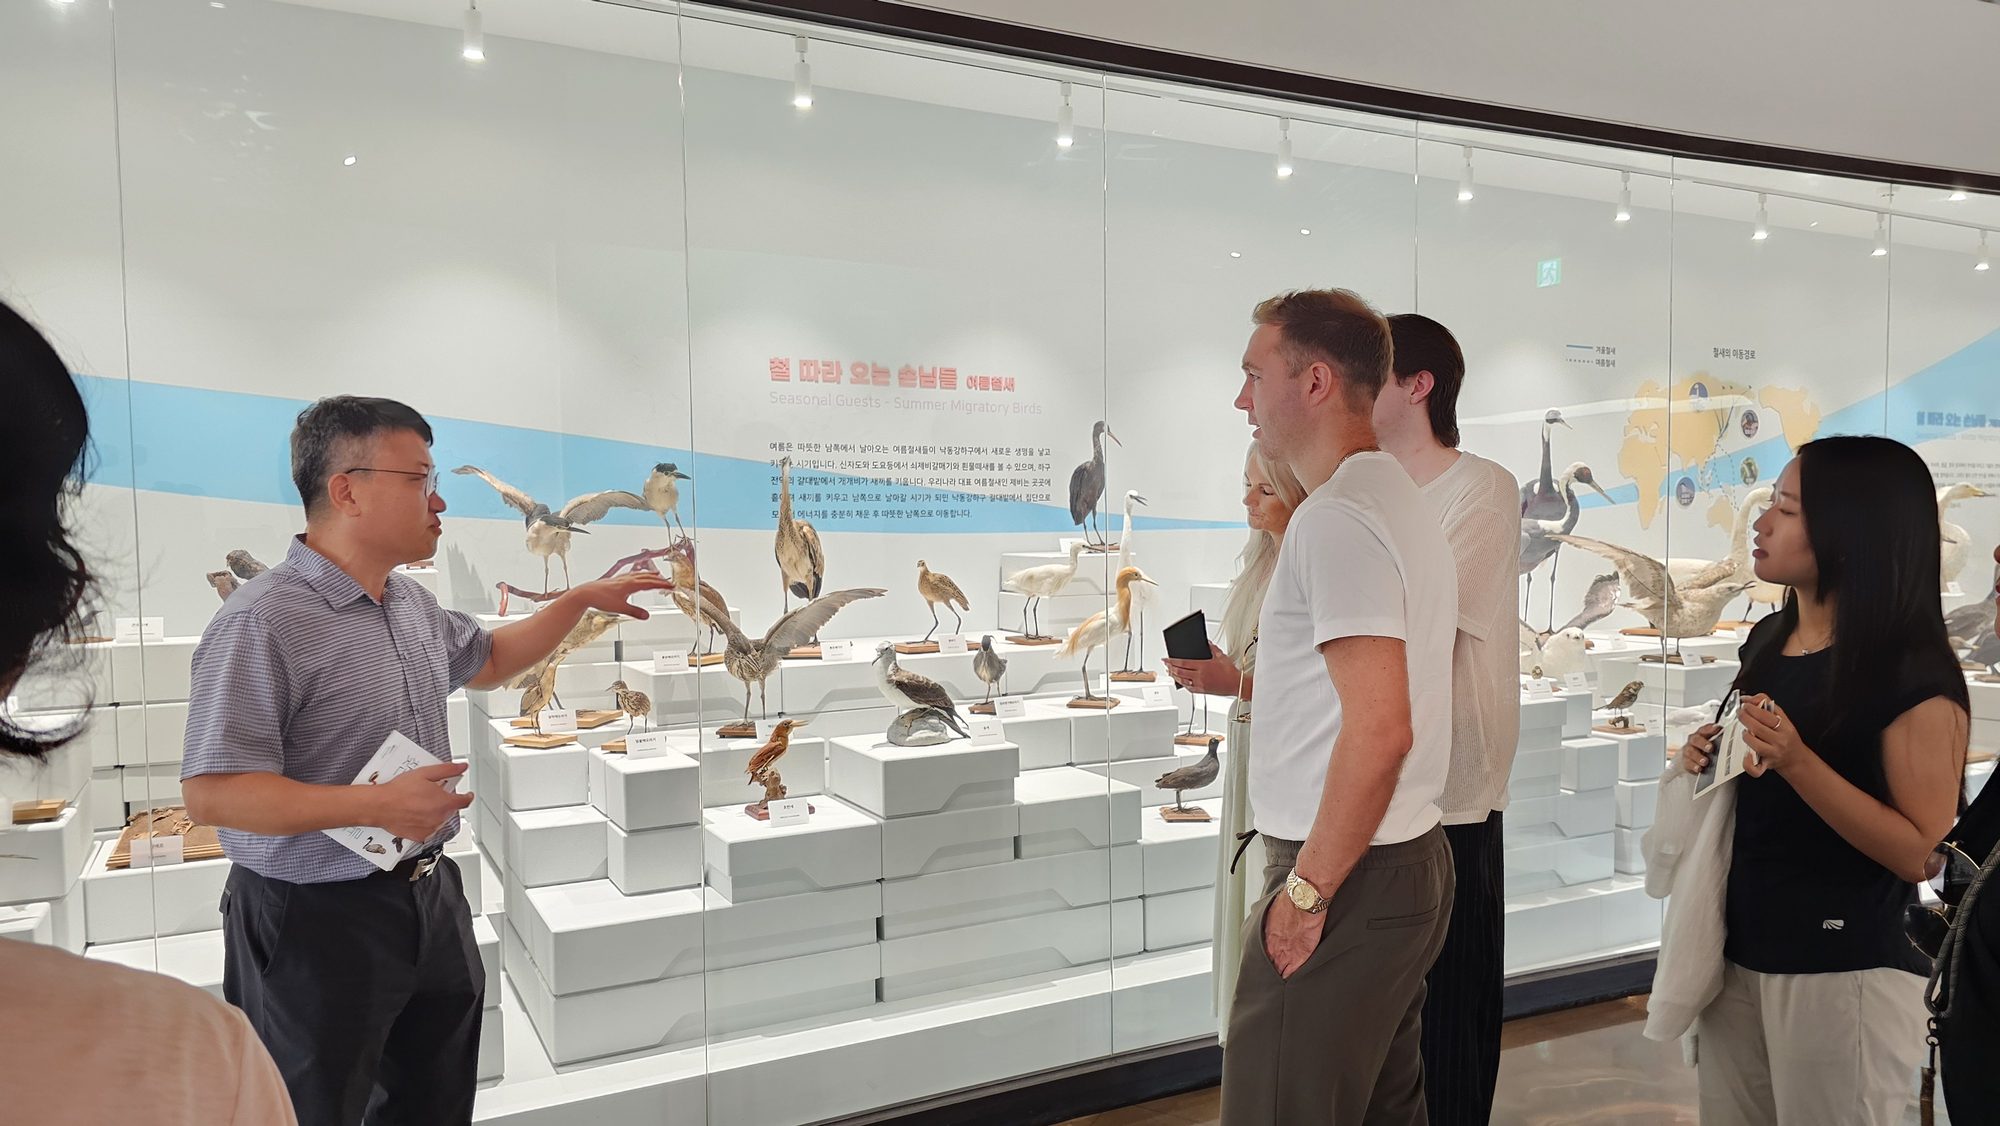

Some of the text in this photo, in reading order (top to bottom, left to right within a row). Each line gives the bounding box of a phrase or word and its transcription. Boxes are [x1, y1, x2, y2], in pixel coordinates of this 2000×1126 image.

[1713, 347, 1756, 360] 철새의 이동경로
[769, 357, 1016, 392] 철 따라 오는 손님들 여름철새
[769, 391, 832, 406] Seasonal
[836, 394, 880, 408] Guests
[894, 396, 948, 411] Summer
[950, 400, 1008, 416] Migratory
[1012, 402, 1042, 414] Birds
[770, 442, 793, 452] 여름은
[798, 443, 821, 452] 따뜻한
[825, 444, 855, 453] 남쪽에서
[860, 444, 889, 454] 날아오는
[892, 445, 936, 454] 여름철새들이
[940, 446, 988, 455] 낙동강하구에서
[796, 460, 838, 469] 시기입니다.
[1015, 463, 1036, 471] 있으며,
[928, 478, 956, 486] 우리나라
[958, 478, 972, 487] 대표
[826, 493, 848, 502] 키우고
[852, 493, 881, 502] 남쪽으로
[885, 494, 907, 502] 날아갈
[911, 494, 932, 502] 시기가
[797, 510, 828, 519] 에너지를
[873, 510, 879, 518] 후
[881, 510, 903, 519] 따뜻한
[906, 510, 934, 518] 남쪽으로
[936, 509, 972, 518] 이동합니다.
